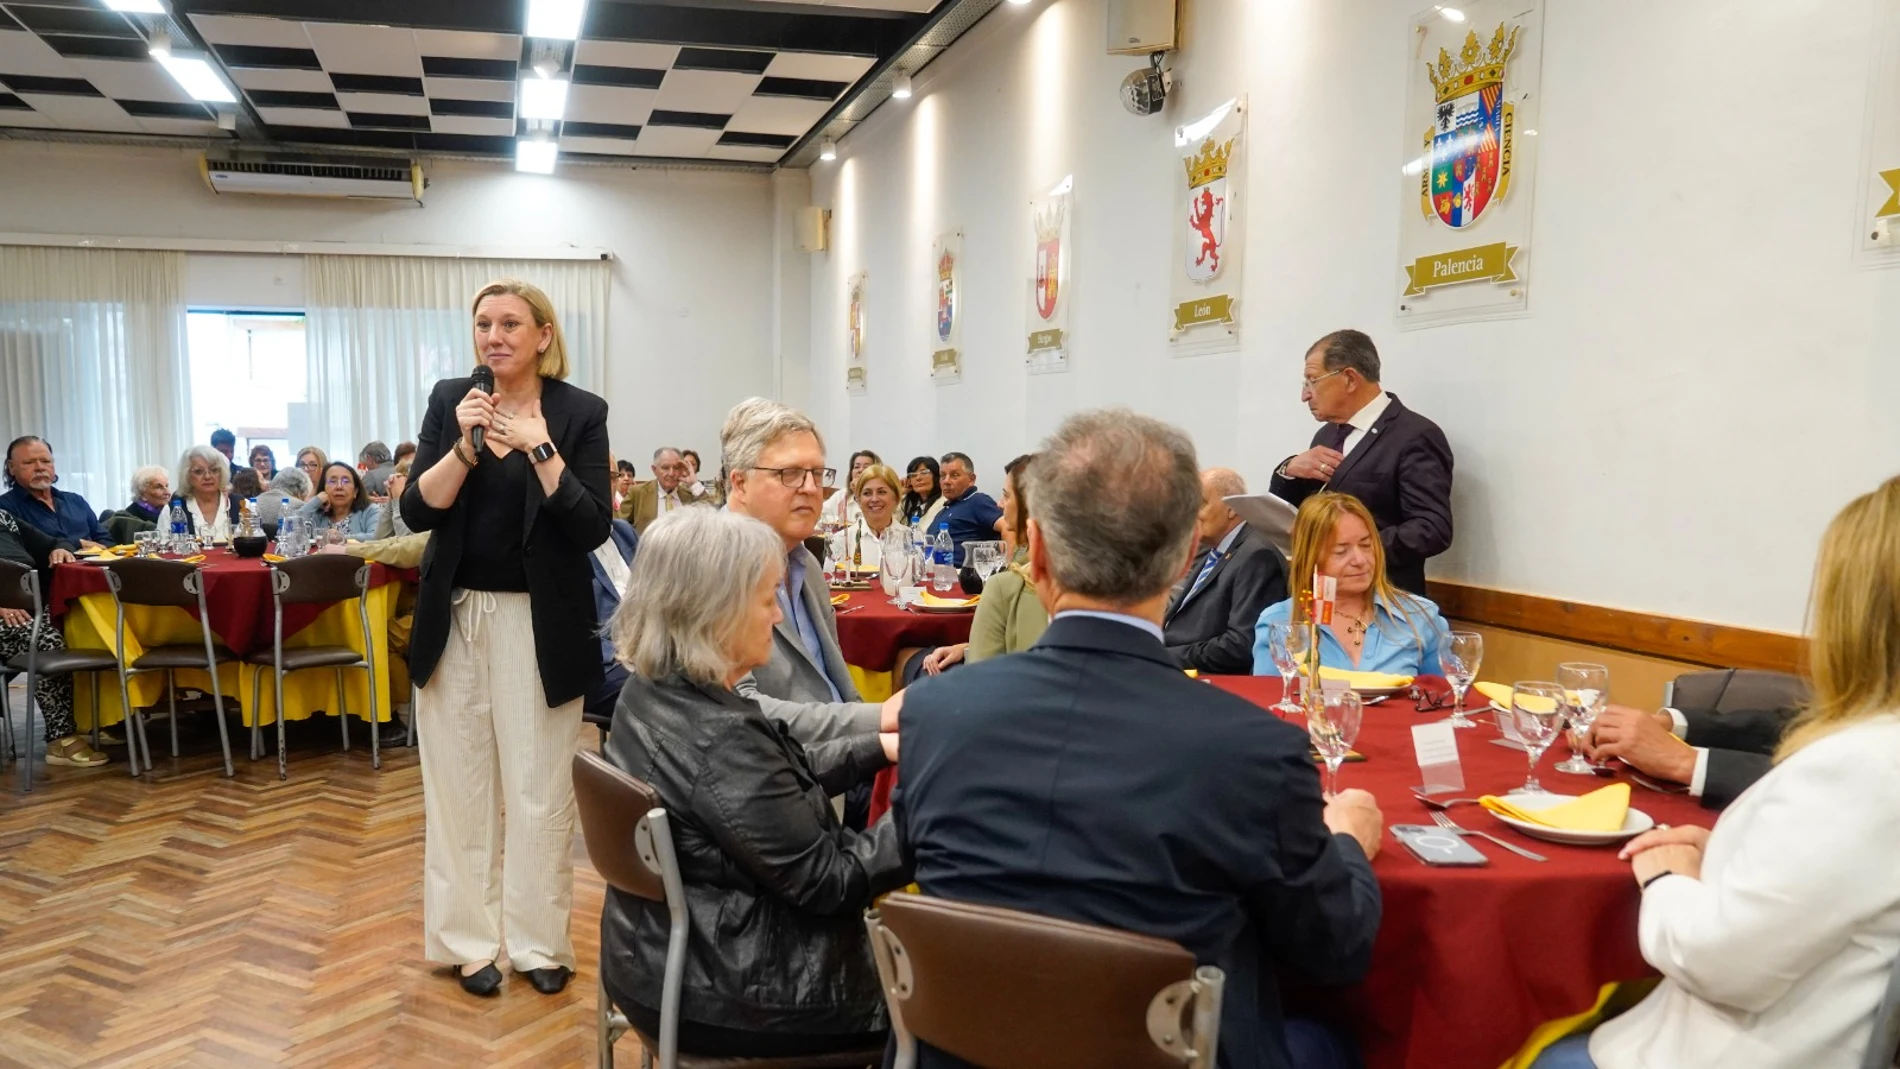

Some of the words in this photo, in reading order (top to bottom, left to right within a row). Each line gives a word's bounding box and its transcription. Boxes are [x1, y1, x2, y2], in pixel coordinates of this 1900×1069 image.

[1502, 112, 1513, 177] CIENCIA
[1432, 254, 1484, 278] Palencia
[1194, 302, 1211, 317] León
